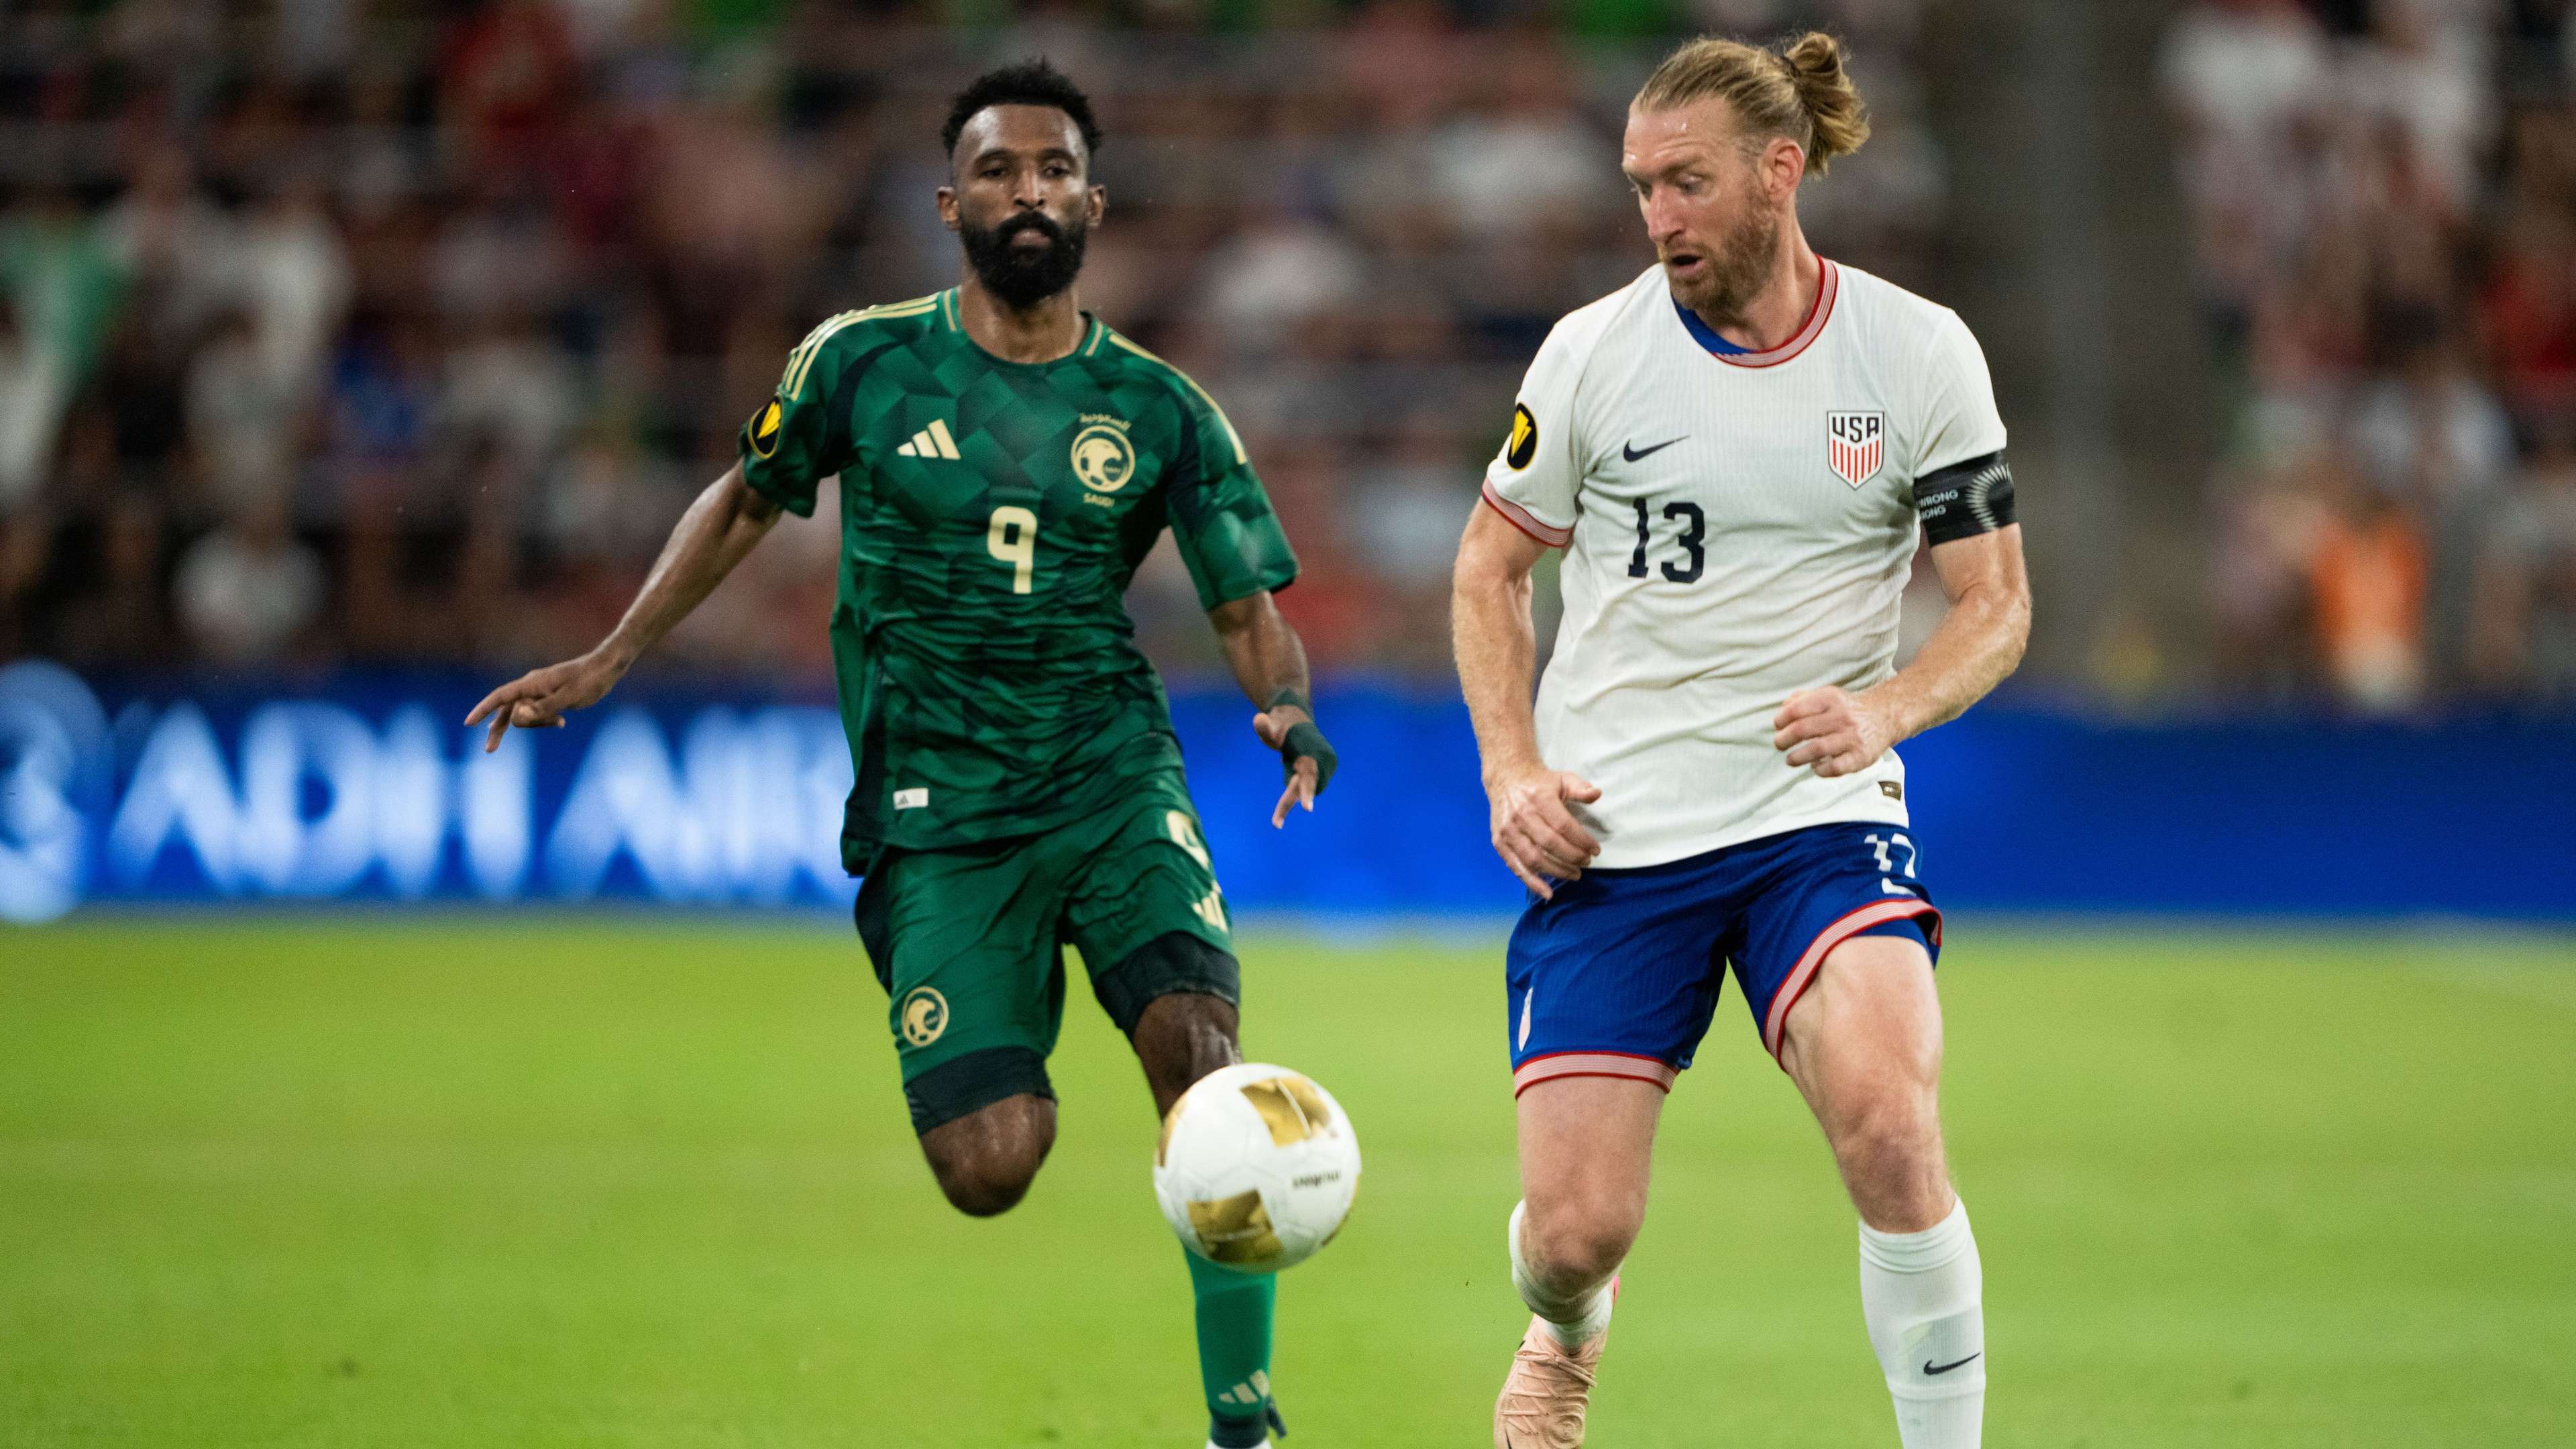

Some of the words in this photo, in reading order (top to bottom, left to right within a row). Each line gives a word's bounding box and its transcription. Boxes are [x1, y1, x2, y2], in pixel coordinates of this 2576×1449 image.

[1832, 417, 1879, 443] USA
[987, 506, 1038, 594] 9
[1627, 497, 1705, 584] 13
[104, 701, 533, 896] ADH
